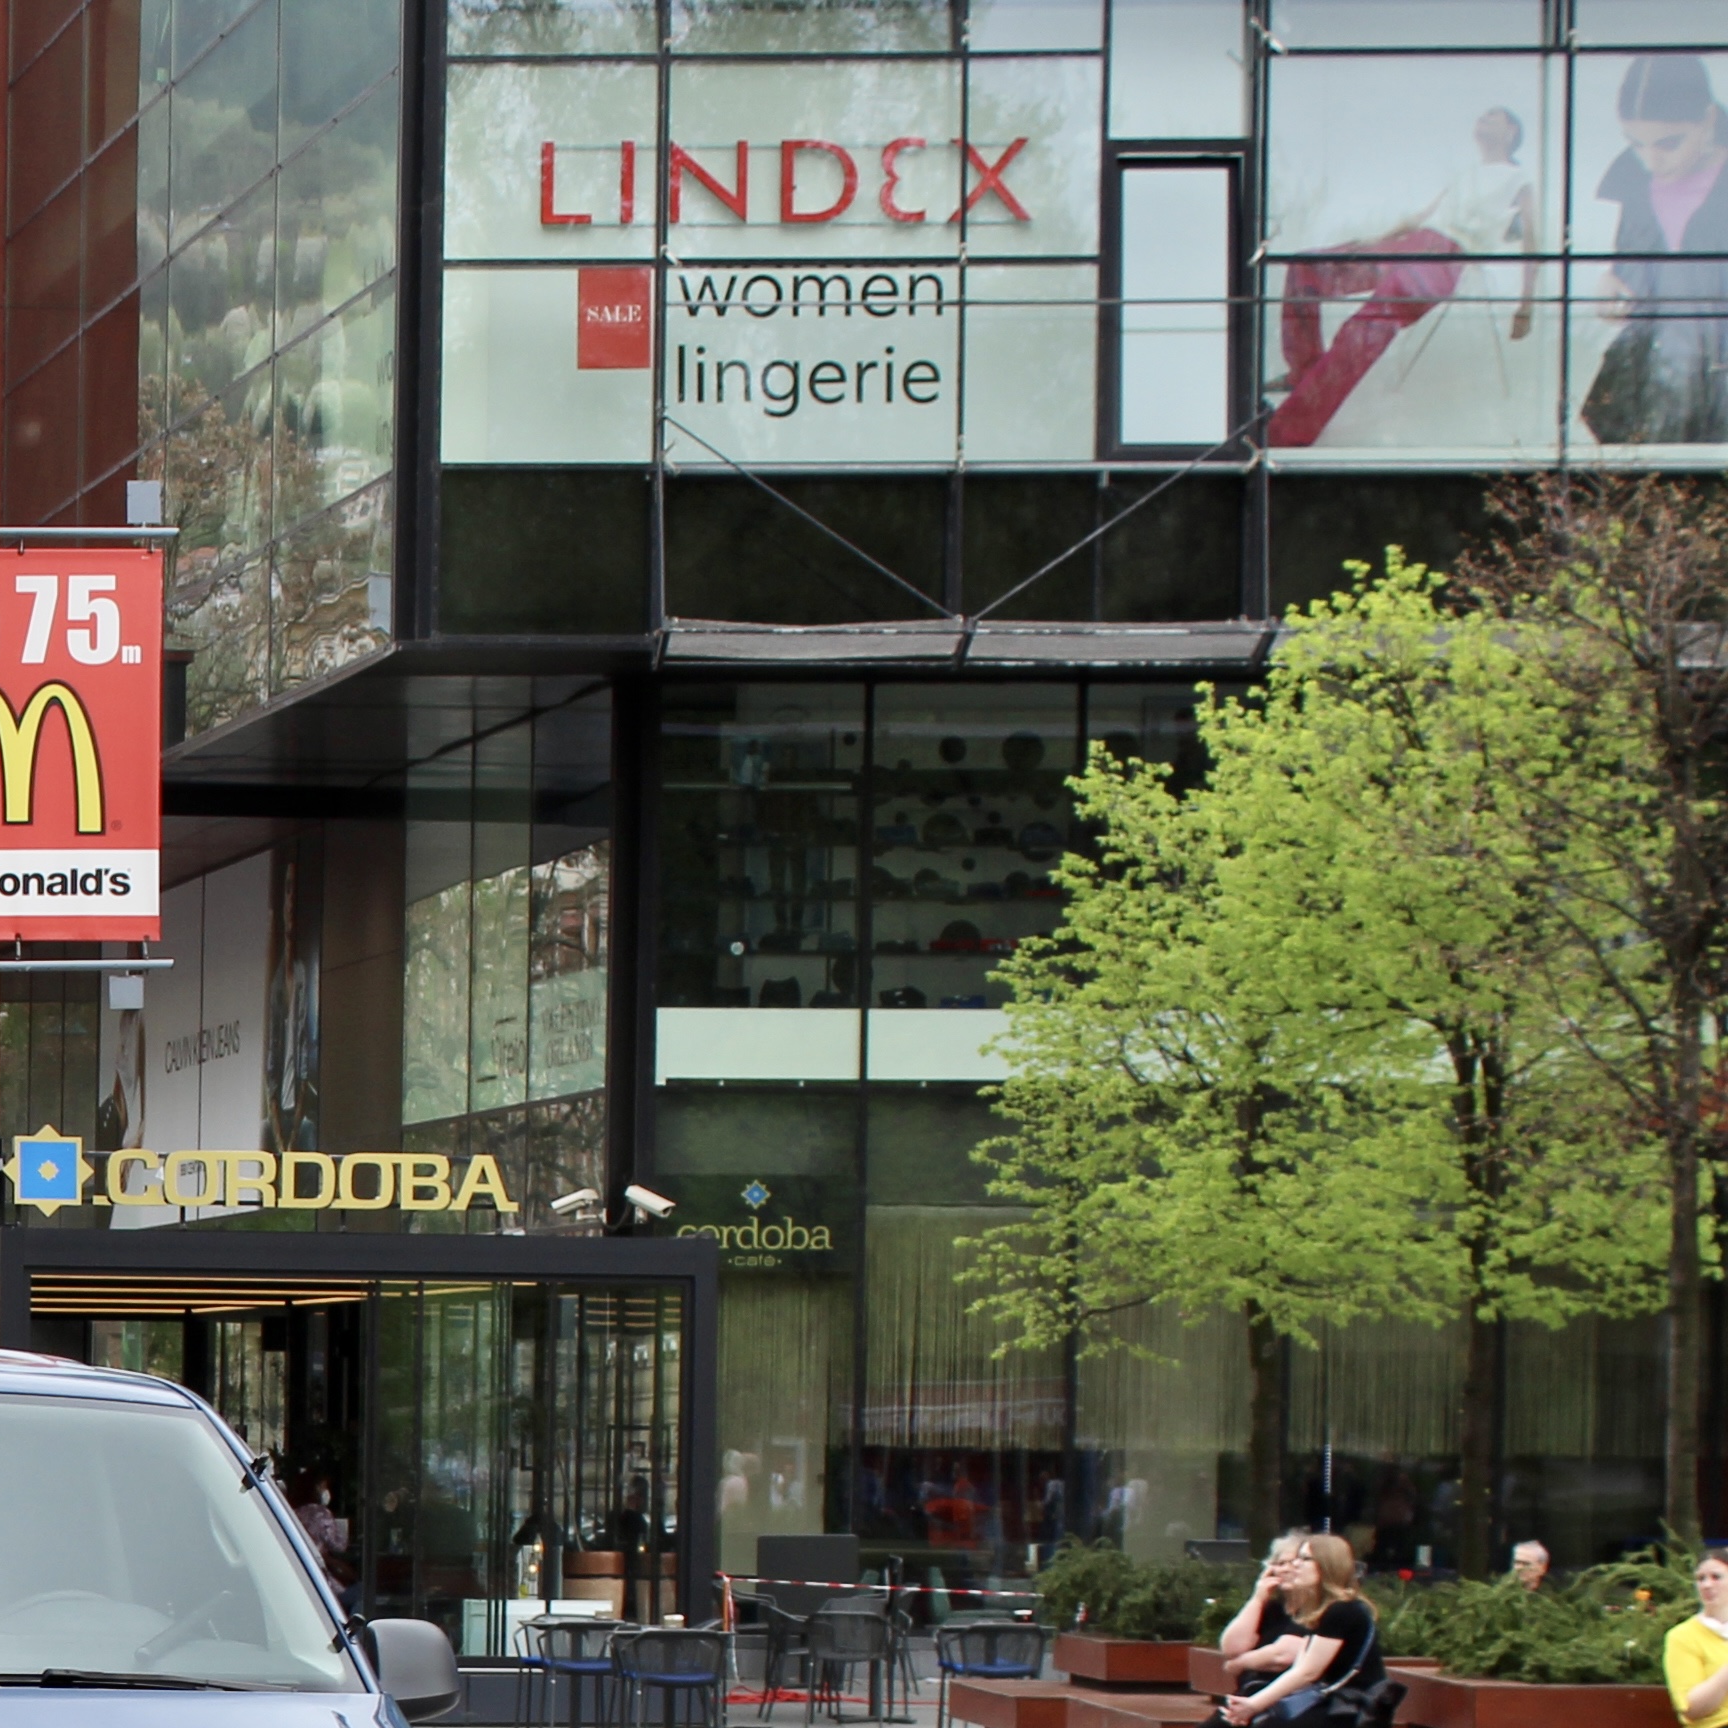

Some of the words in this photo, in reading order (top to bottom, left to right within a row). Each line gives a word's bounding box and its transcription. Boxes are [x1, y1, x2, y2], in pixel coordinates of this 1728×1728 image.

[540, 137, 1032, 225] LINDEX
[587, 305, 642, 324] SALE
[678, 272, 944, 318] women
[677, 345, 942, 418] lingerie
[104, 1149, 520, 1213] CORDOBA
